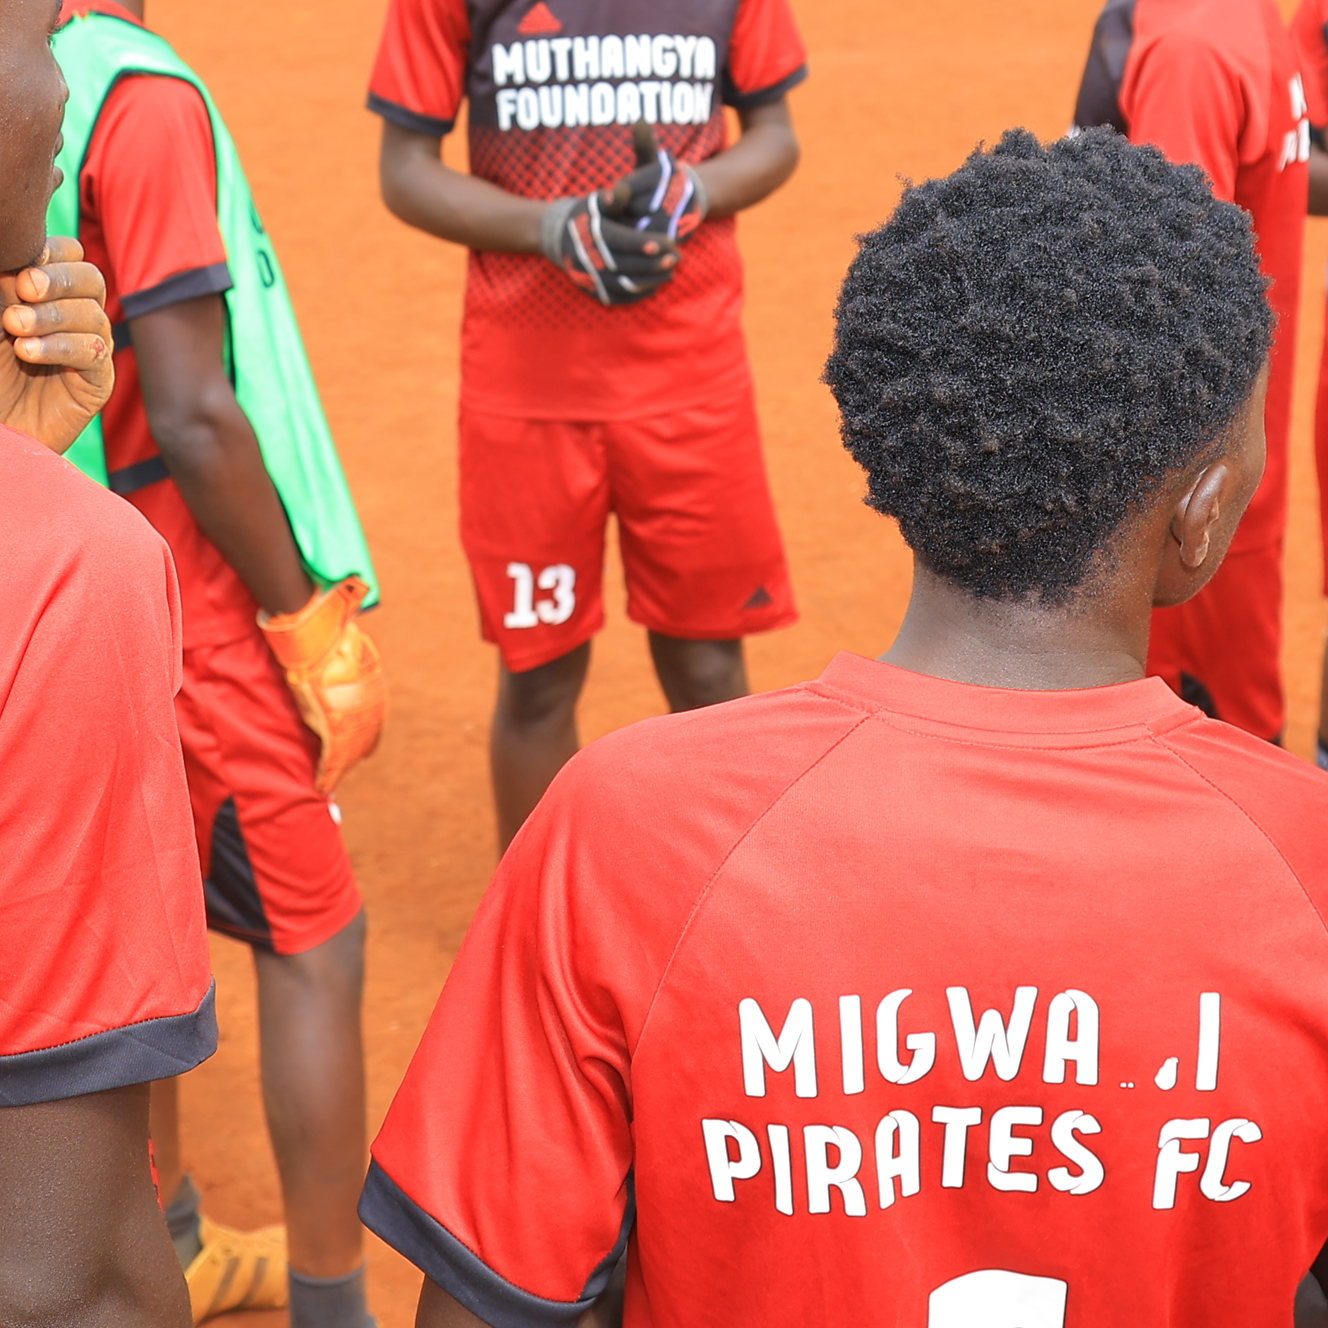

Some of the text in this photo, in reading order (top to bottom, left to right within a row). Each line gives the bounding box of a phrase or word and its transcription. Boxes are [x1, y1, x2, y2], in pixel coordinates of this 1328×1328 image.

[491, 33, 717, 87] MUTHANGYA
[495, 80, 714, 132] FOUNDATION
[503, 561, 577, 630] 13
[738, 985, 1221, 1099] MIGWAI
[701, 1105, 1263, 1218] PIRATES FC
